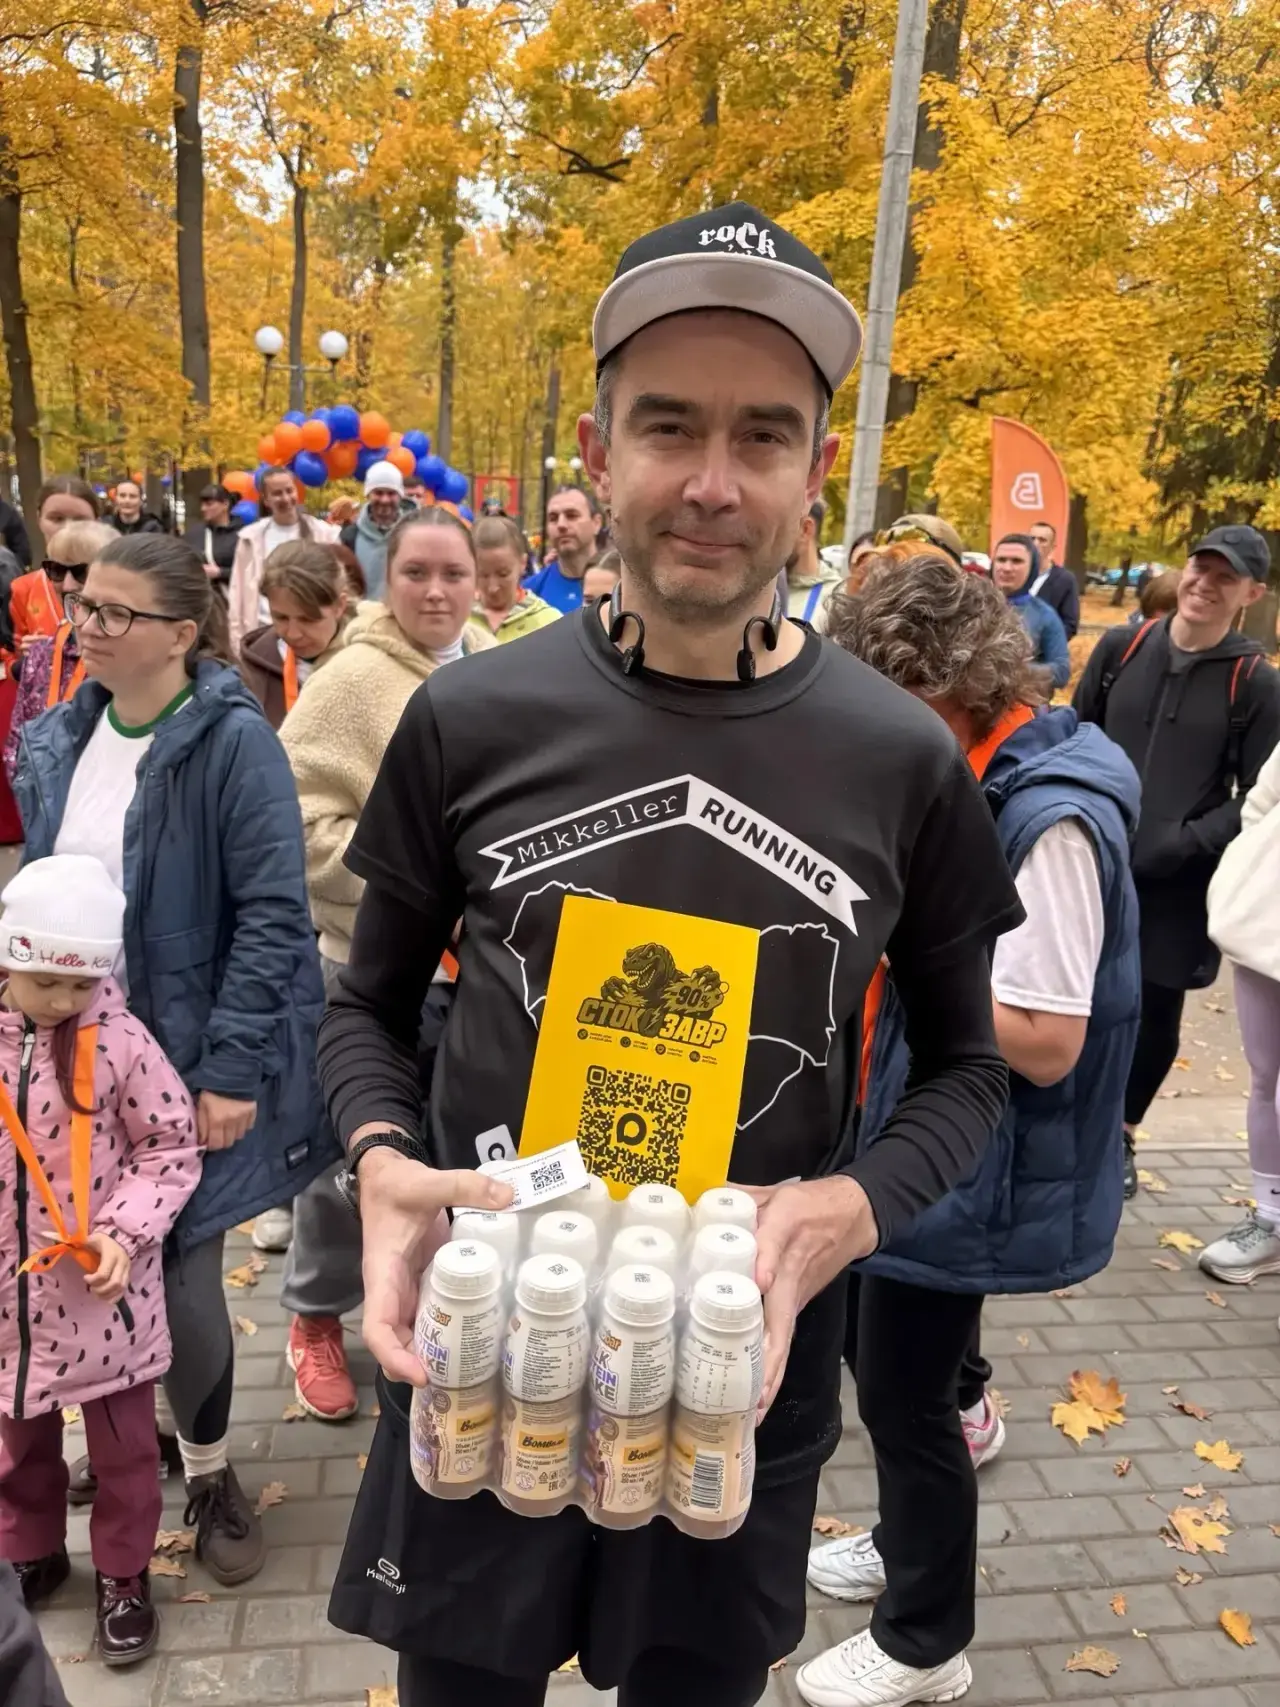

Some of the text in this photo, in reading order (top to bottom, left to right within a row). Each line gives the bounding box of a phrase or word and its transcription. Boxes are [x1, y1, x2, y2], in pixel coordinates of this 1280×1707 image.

[517, 795, 837, 896] Mikkeller RUNNING
[40, 950, 86, 968] Hello
[366, 1567, 406, 1595] Kalenji
